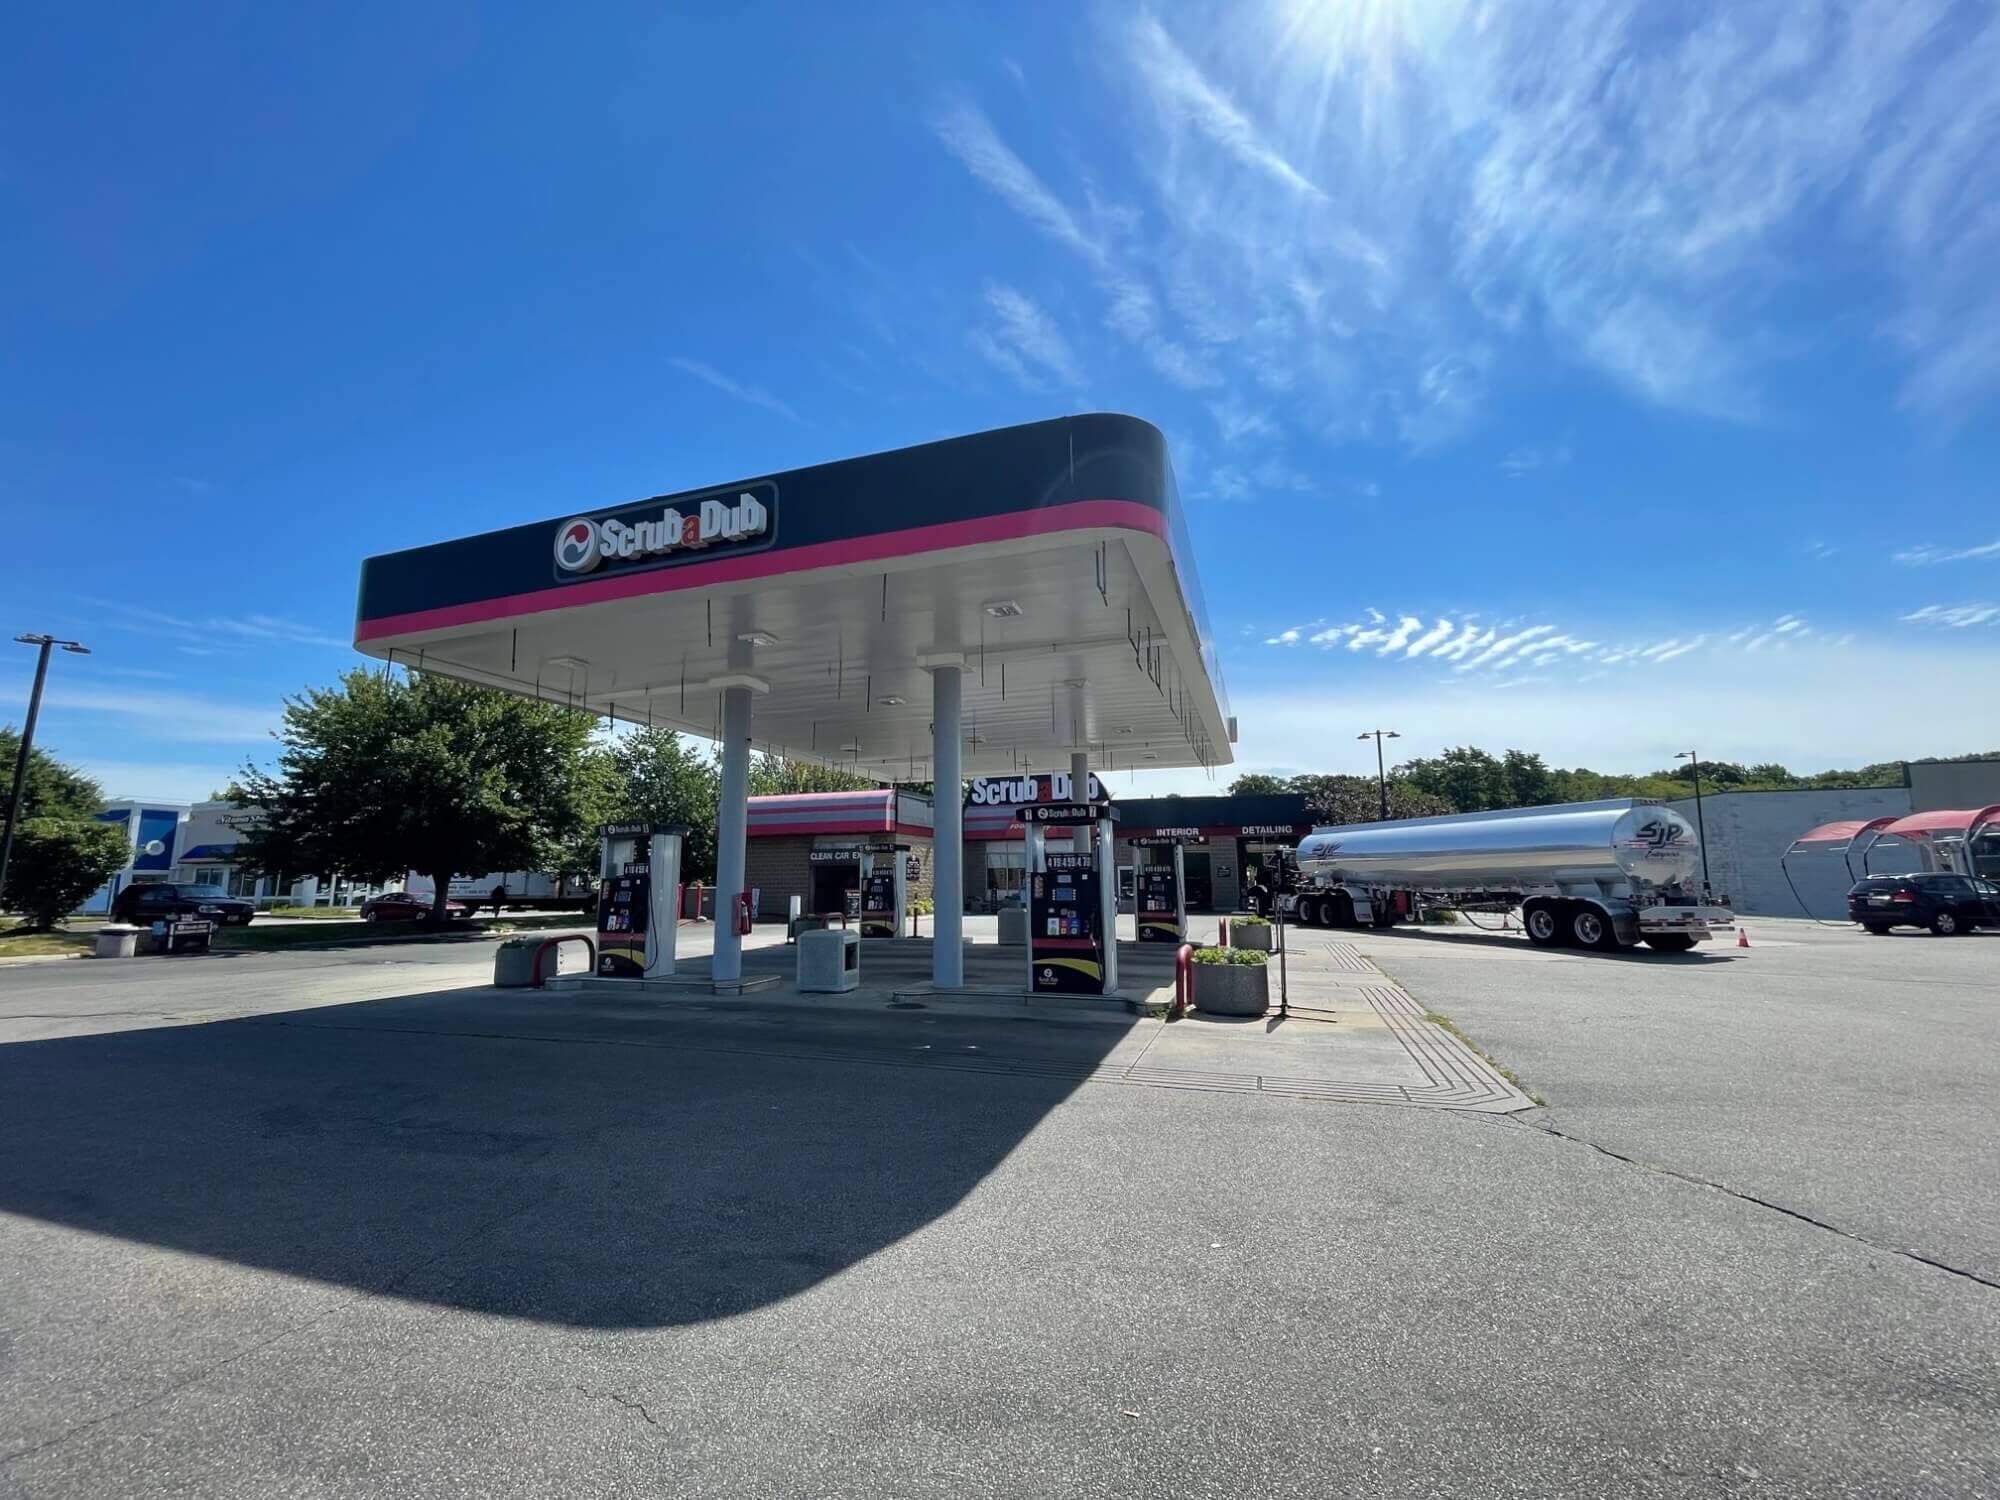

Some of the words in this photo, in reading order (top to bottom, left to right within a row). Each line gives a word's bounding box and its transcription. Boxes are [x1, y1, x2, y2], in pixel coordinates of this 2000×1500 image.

[1156, 827, 1199, 837] INTERIOR
[1241, 825, 1293, 835] DETAILING
[810, 851, 833, 860] CLEAN
[834, 851, 849, 860] CAR
